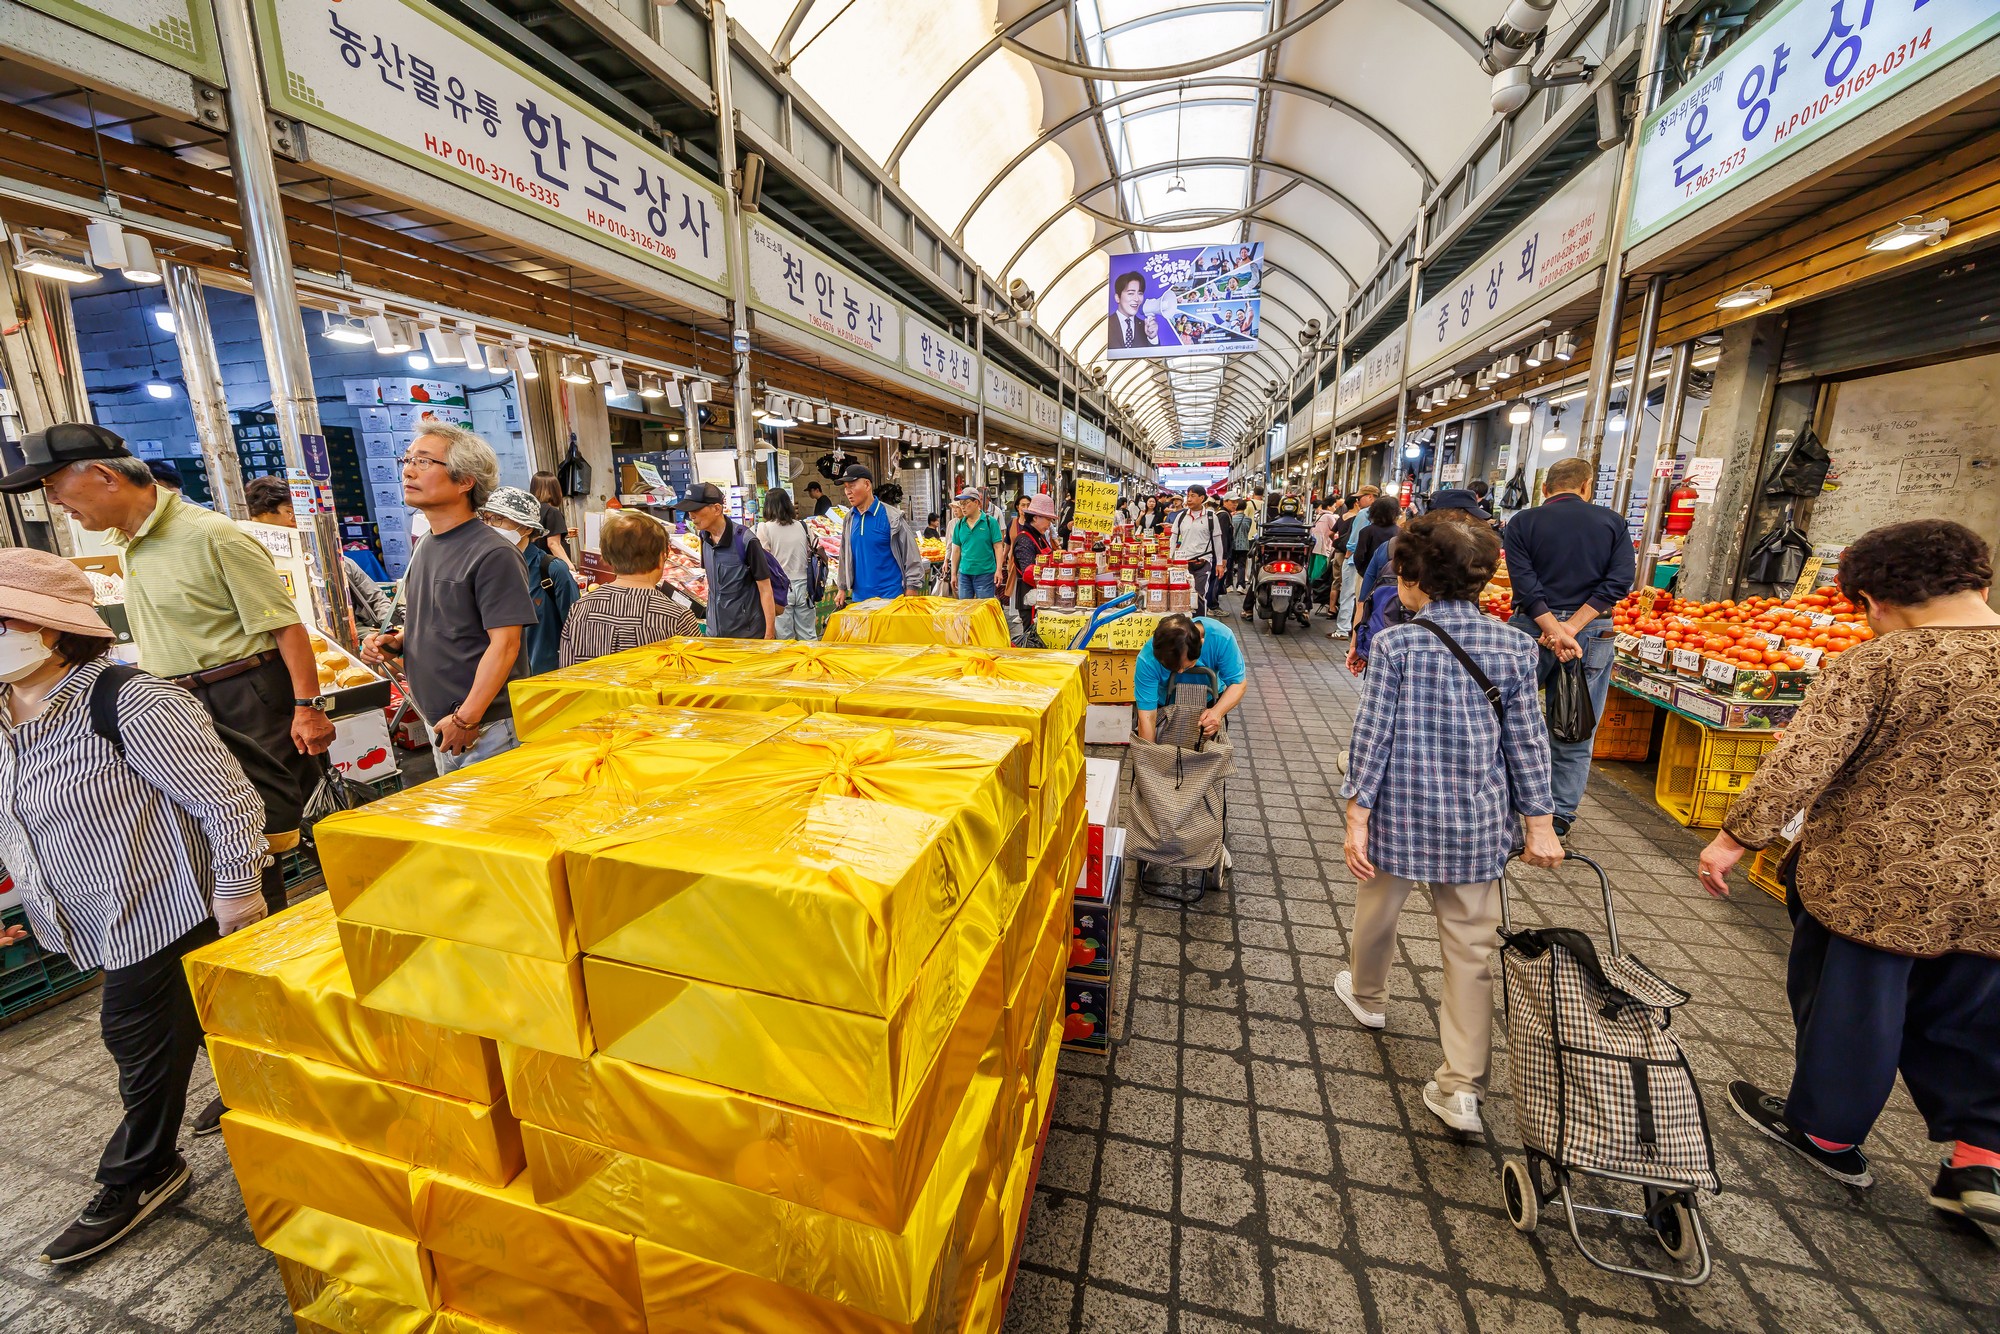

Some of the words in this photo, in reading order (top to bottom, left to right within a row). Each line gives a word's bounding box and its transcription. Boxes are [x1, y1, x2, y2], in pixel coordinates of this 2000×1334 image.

[1659, 71, 1724, 136] 청과위탁판매
[1673, 0, 1932, 188] 온양상
[1774, 114, 1799, 143] H.P
[1801, 27, 1932, 126] 010-9169-0314
[329, 9, 501, 138] 농산물유통
[516, 99, 711, 258] 한도상사
[424, 132, 453, 159] H.P
[456, 147, 560, 208] 010-3716-5335
[1685, 182, 1694, 198] T.
[1695, 148, 1746, 192] 963-7573
[587, 208, 606, 229] H.P
[608, 220, 677, 260] 010-3126-7289
[754, 229, 766, 248] 청과
[783, 251, 883, 343] 천안농산
[1438, 232, 1539, 343] 중앙상회
[921, 332, 970, 385] 한농상회
[1038, 627, 1066, 639] 조개젓
[1116, 616, 1152, 627] 오징어젓
[1090, 679, 1135, 698] 토하
[1091, 658, 1136, 677] 갈치속
